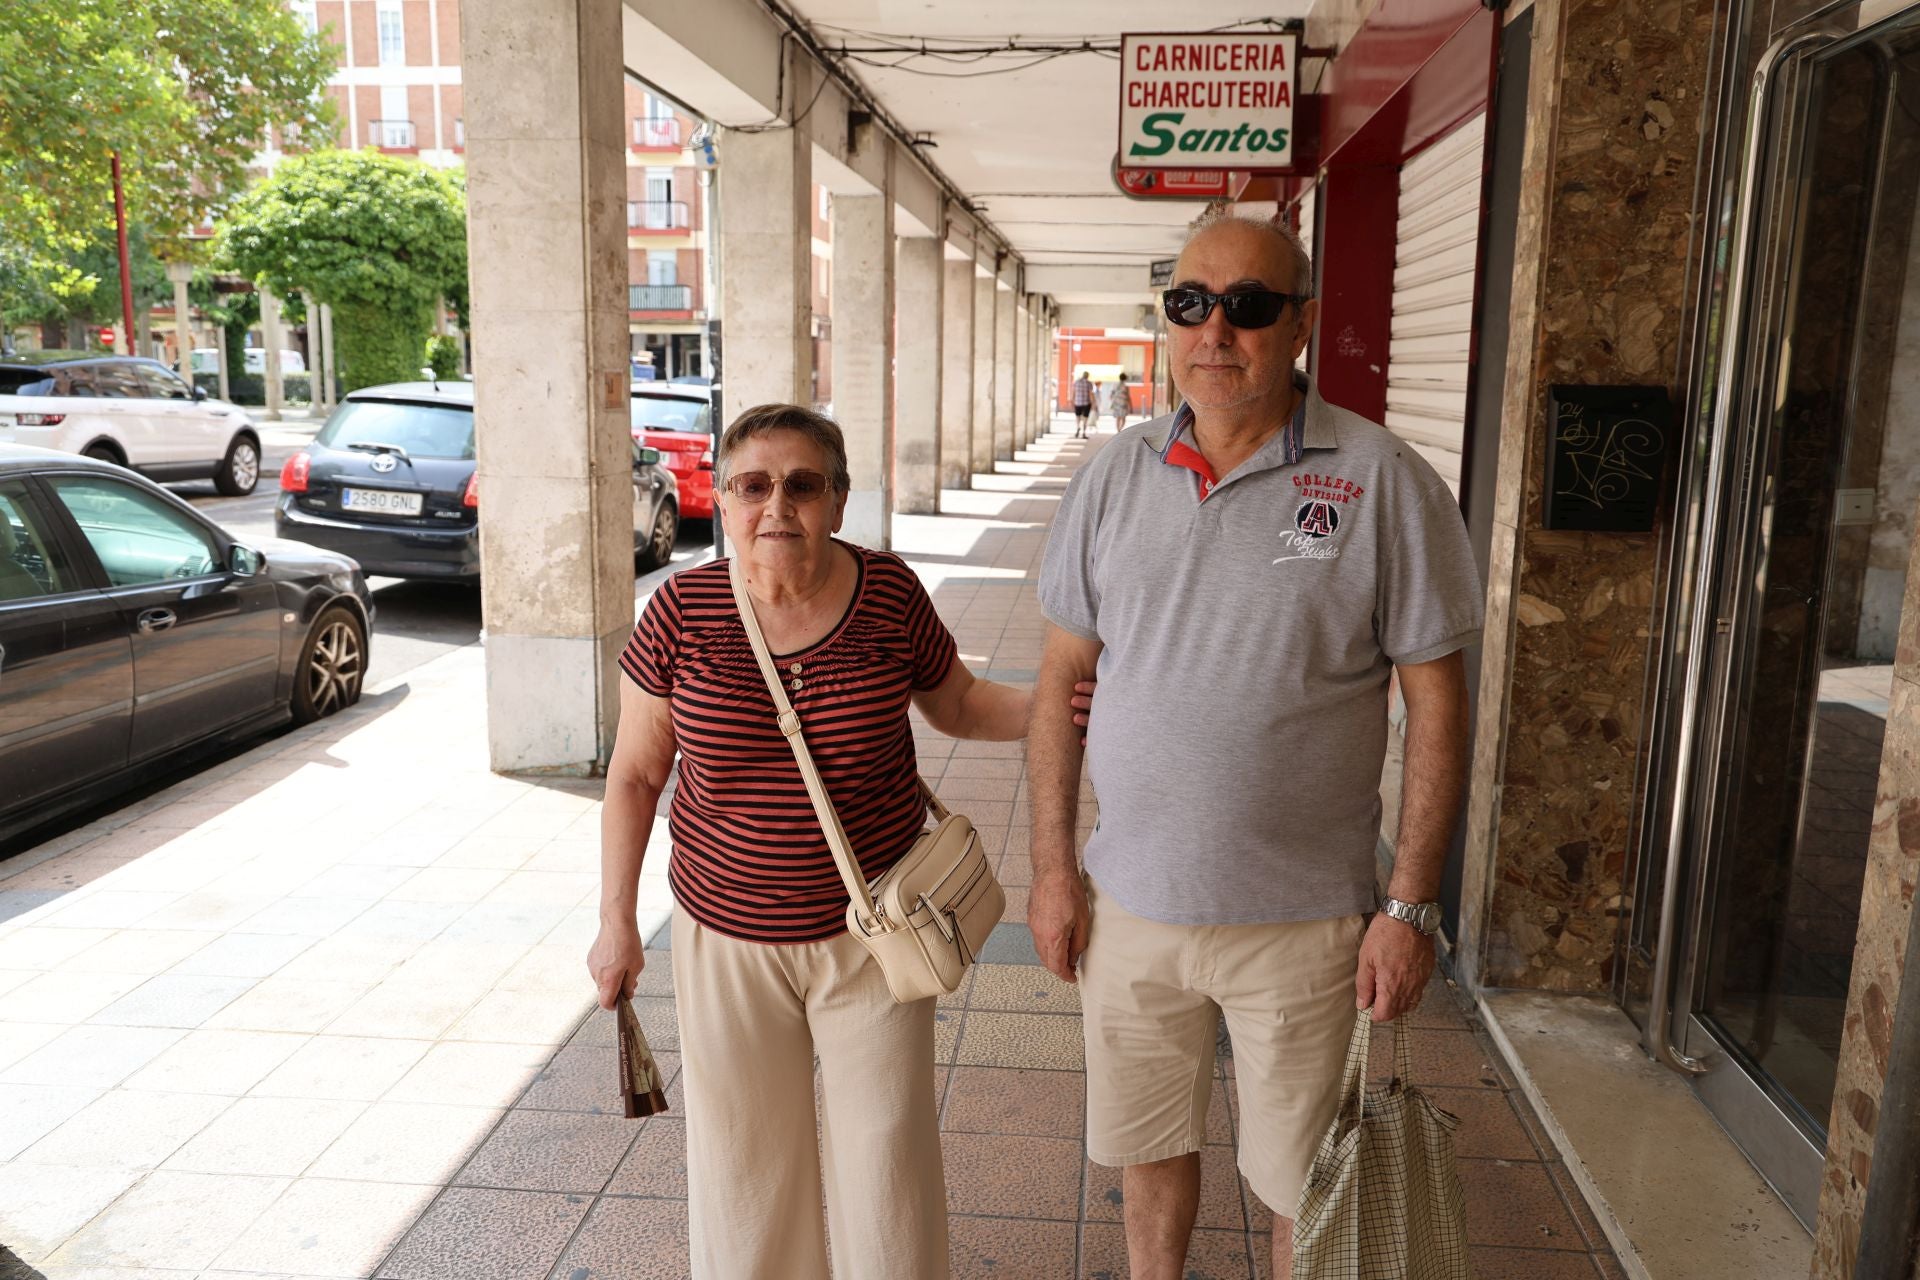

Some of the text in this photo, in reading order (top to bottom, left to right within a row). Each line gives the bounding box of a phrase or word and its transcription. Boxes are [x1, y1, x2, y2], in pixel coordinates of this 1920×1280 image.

[1136, 43, 1286, 72] CARNICERIA
[1128, 81, 1291, 109] CHARCUTERIA
[1129, 112, 1289, 156] Santos
[1292, 473, 1364, 499] COLLEGE
[1302, 488, 1350, 504] DIVISION
[352, 492, 417, 510] 2580 GNL
[1301, 500, 1333, 535] A
[1279, 530, 1316, 549] Top
